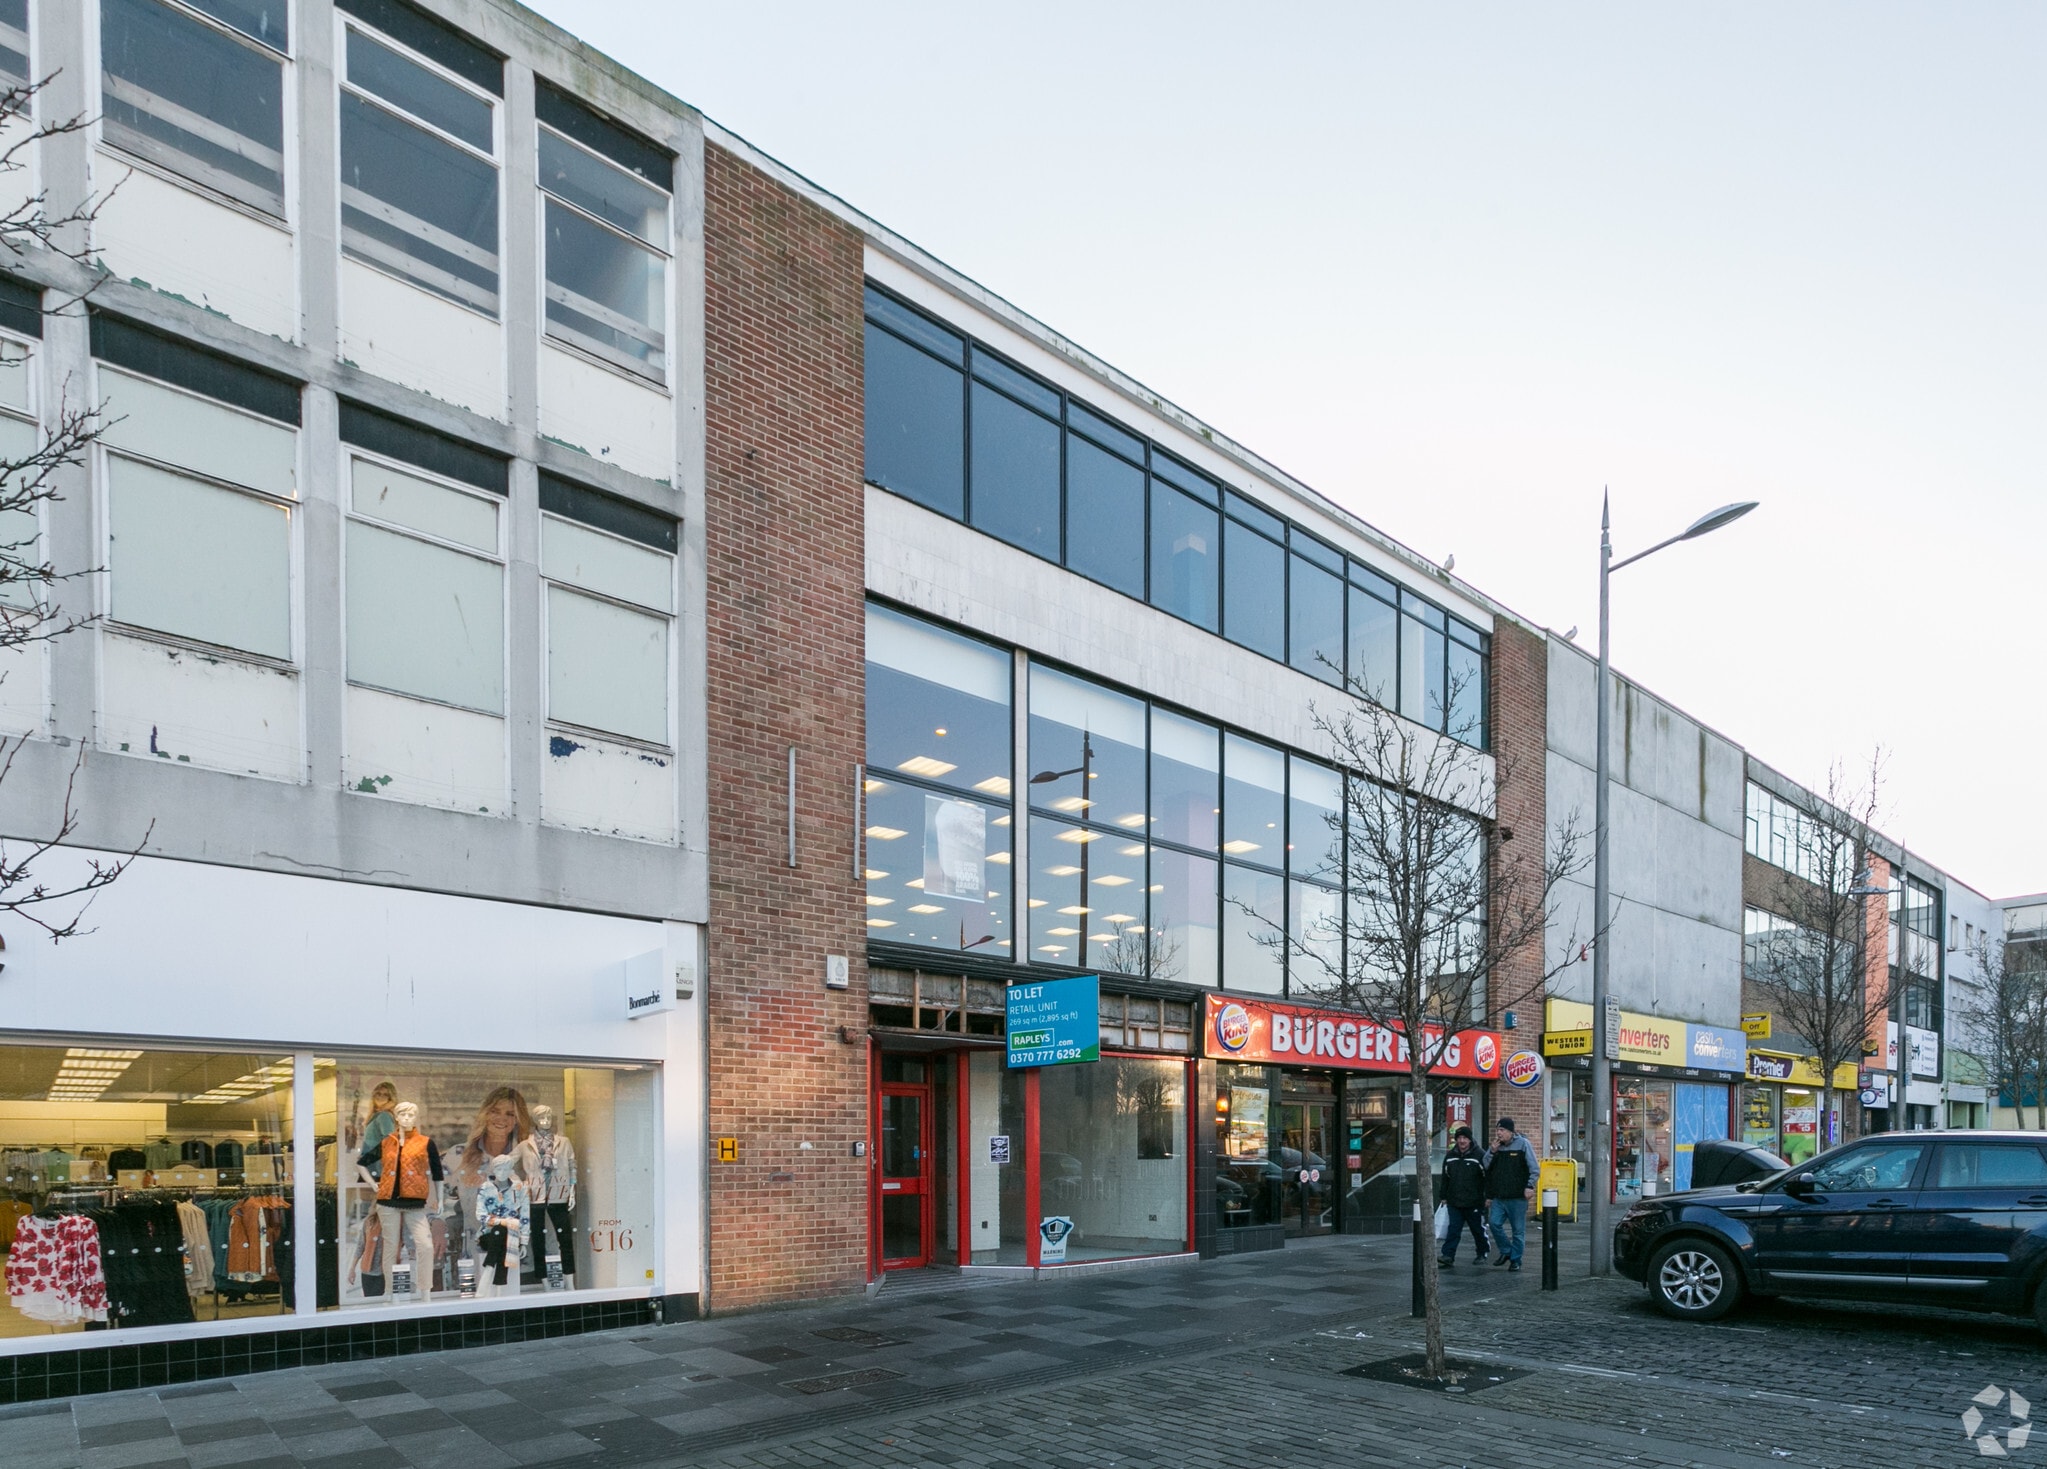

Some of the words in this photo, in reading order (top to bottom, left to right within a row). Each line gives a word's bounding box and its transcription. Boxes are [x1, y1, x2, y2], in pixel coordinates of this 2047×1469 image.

[628, 989, 661, 1010] Bonmarché
[1009, 989, 1022, 1001] TO
[1024, 986, 1043, 999] LET
[1009, 1004, 1036, 1015] RETAIL
[1038, 1001, 1058, 1012] UNIT
[1223, 1013, 1247, 1029] BURGER
[1014, 1033, 1051, 1046] RAPLEYS
[1056, 1039, 1074, 1047] .com
[1223, 1022, 1248, 1042] KING
[1271, 1012, 1394, 1063] BURGER
[1397, 1033, 1461, 1068] KNG
[1618, 1027, 1670, 1050] nverters
[1695, 1030, 1714, 1045] cash
[1478, 1042, 1494, 1055] BURGER
[1546, 1036, 1585, 1045] WESTERN
[1010, 1052, 1034, 1064] 0370
[1036, 1050, 1055, 1061] 777
[1056, 1048, 1081, 1060] 6292
[1478, 1049, 1495, 1065] KING
[1693, 1043, 1737, 1060] converters
[1507, 1056, 1536, 1072] BURGER
[1508, 1062, 1537, 1081] KING
[1753, 1056, 1785, 1077] Premier
[720, 1140, 735, 1159] H
[598, 1219, 622, 1227] FROM
[589, 1228, 634, 1253] £16
